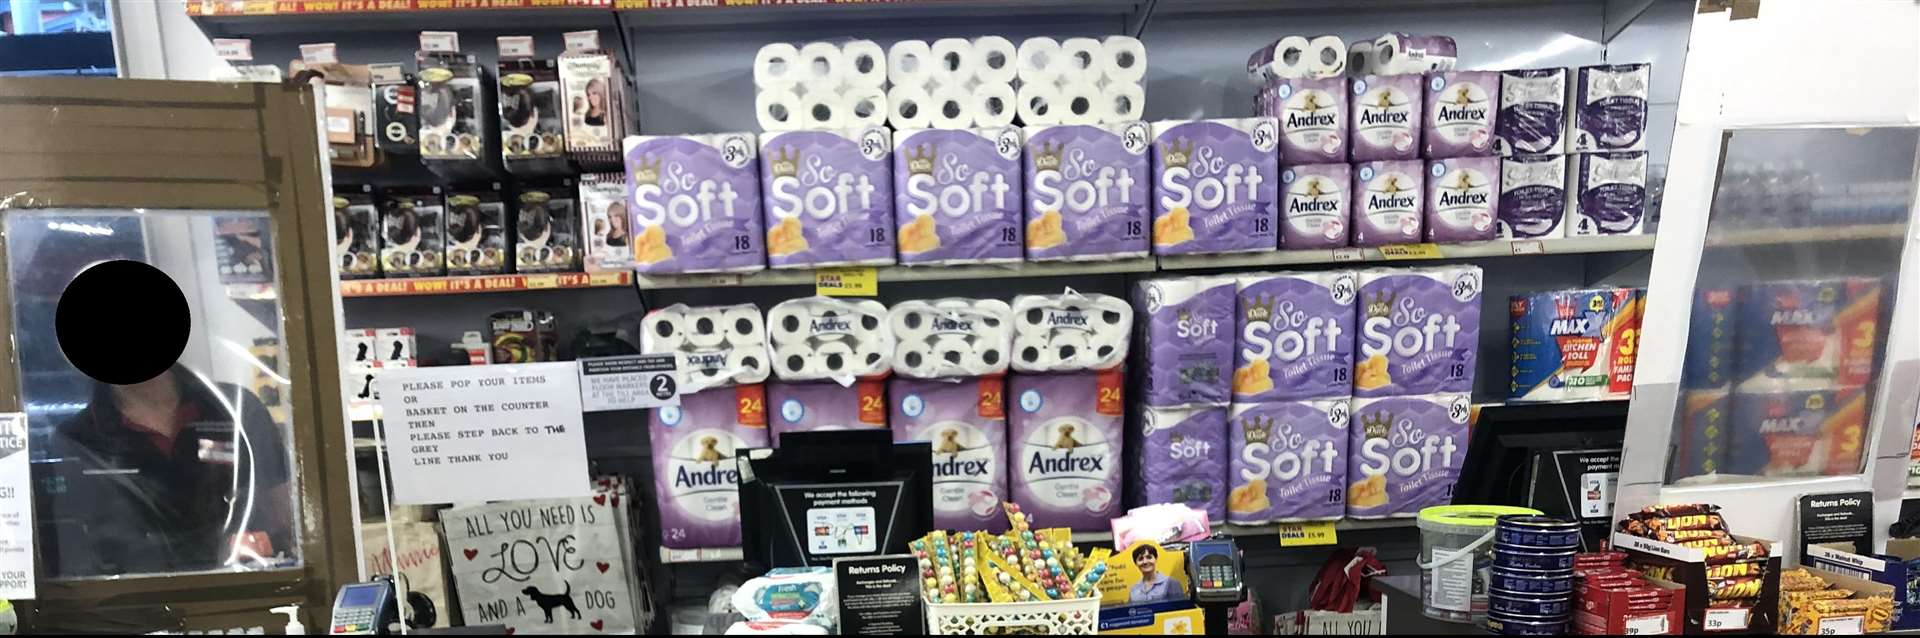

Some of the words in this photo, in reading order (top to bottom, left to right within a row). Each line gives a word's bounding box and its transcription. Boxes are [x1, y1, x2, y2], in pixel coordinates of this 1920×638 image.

[304, 1, 337, 10] WOW!
[341, 1, 364, 10] IT'S
[366, 0, 377, 9] A
[378, 0, 409, 9] DEAL!
[418, 0, 448, 8] WOW!
[616, 0, 648, 9] WOW!
[652, 0, 674, 8] IT'S
[1287, 113, 1336, 128] Andrex
[1361, 109, 1409, 125] Andrex
[1438, 106, 1486, 121] Andrex
[1577, 133, 1587, 146] 4
[937, 152, 971, 185] So
[1064, 148, 1097, 181] So
[1191, 145, 1225, 178] So
[664, 161, 698, 194] So
[802, 154, 836, 187] So
[1033, 167, 1135, 214] Soft
[1161, 163, 1263, 210] Soft
[772, 172, 875, 219] Soft
[907, 171, 1010, 218] Soft
[1439, 192, 1488, 206] Andrex
[635, 181, 738, 228] Soft
[1290, 198, 1338, 214] Andrex
[1369, 195, 1417, 210] Andrex
[1127, 221, 1142, 236] 18
[1255, 217, 1269, 232] 18
[1578, 218, 1588, 231] 4
[870, 228, 885, 242] 18
[1002, 227, 1017, 241] 18
[735, 236, 750, 250] 18
[365, 281, 374, 292] A
[377, 280, 407, 292] DEAL!
[413, 279, 447, 291] WOW!
[450, 279, 471, 290] IT'S
[473, 279, 484, 290] A
[485, 277, 516, 289] DEAL!
[557, 273, 580, 286] IT'S
[580, 273, 589, 285] A
[1274, 301, 1308, 331] So
[1393, 296, 1427, 327] So
[809, 319, 851, 333] Andrex
[931, 318, 973, 332] Andrex
[1047, 313, 1088, 327] Andrex
[1176, 318, 1218, 338] Soft
[1361, 313, 1461, 358] Soft
[1856, 321, 1876, 348] 3
[1242, 317, 1342, 362] Soft
[1619, 328, 1635, 355] 3
[1333, 367, 1347, 382] 18
[1450, 364, 1464, 378] 18
[402, 381, 444, 392] PLEASE
[450, 379, 471, 389] POP
[478, 377, 505, 387] YOUR
[513, 375, 546, 385] ITEMS
[656, 375, 668, 392] 2
[403, 395, 418, 404] OR
[983, 391, 1002, 406] 24
[1100, 387, 1121, 402] 24
[405, 406, 447, 416] BASKET
[453, 405, 468, 414] ON
[474, 404, 495, 413] THE
[501, 401, 549, 411] COUNTER
[740, 397, 762, 414] 24
[863, 396, 884, 411] 24
[408, 419, 436, 430] THEN
[410, 431, 451, 442] PLEASE
[457, 429, 485, 439] STEP
[491, 427, 519, 437] BACK
[524, 426, 539, 435] TO
[544, 424, 566, 435] THE
[1271, 424, 1305, 451] So
[1392, 418, 1425, 448] So
[1840, 425, 1860, 454] 3
[411, 444, 439, 454] GREY
[1170, 440, 1211, 459] Soft
[1360, 434, 1457, 477] Soft
[414, 457, 441, 466] LINE
[448, 454, 482, 465] THANK
[489, 452, 509, 461] YOU
[932, 456, 989, 477] ndrex
[1029, 450, 1104, 475] Andrex
[1241, 440, 1338, 482] Soft
[1590, 456, 1609, 464] accept
[676, 464, 738, 488] Andre
[804, 491, 815, 499] We
[816, 491, 837, 500] accept
[837, 490, 847, 498] the
[848, 489, 877, 498] following
[813, 499, 840, 507] payment
[841, 497, 868, 505] methods
[1328, 489, 1342, 502] 18
[1810, 499, 1838, 508] Returns
[1839, 497, 1862, 507] Policy
[466, 514, 494, 538] ALL
[501, 508, 533, 533] YOU
[540, 504, 575, 525] NEED
[581, 504, 595, 524] IS
[1668, 515, 1707, 529] LION
[672, 528, 686, 539] 24
[482, 534, 584, 584] LOVE
[2, 571, 26, 580] YOUR
[848, 566, 880, 575] Returns
[881, 563, 906, 575] Policy
[1717, 579, 1761, 598] LION
[478, 599, 509, 623] AND
[516, 597, 526, 616] A
[585, 590, 616, 610] DOG
[1708, 619, 1722, 628] 33p
[1822, 628, 1836, 636] 35p
